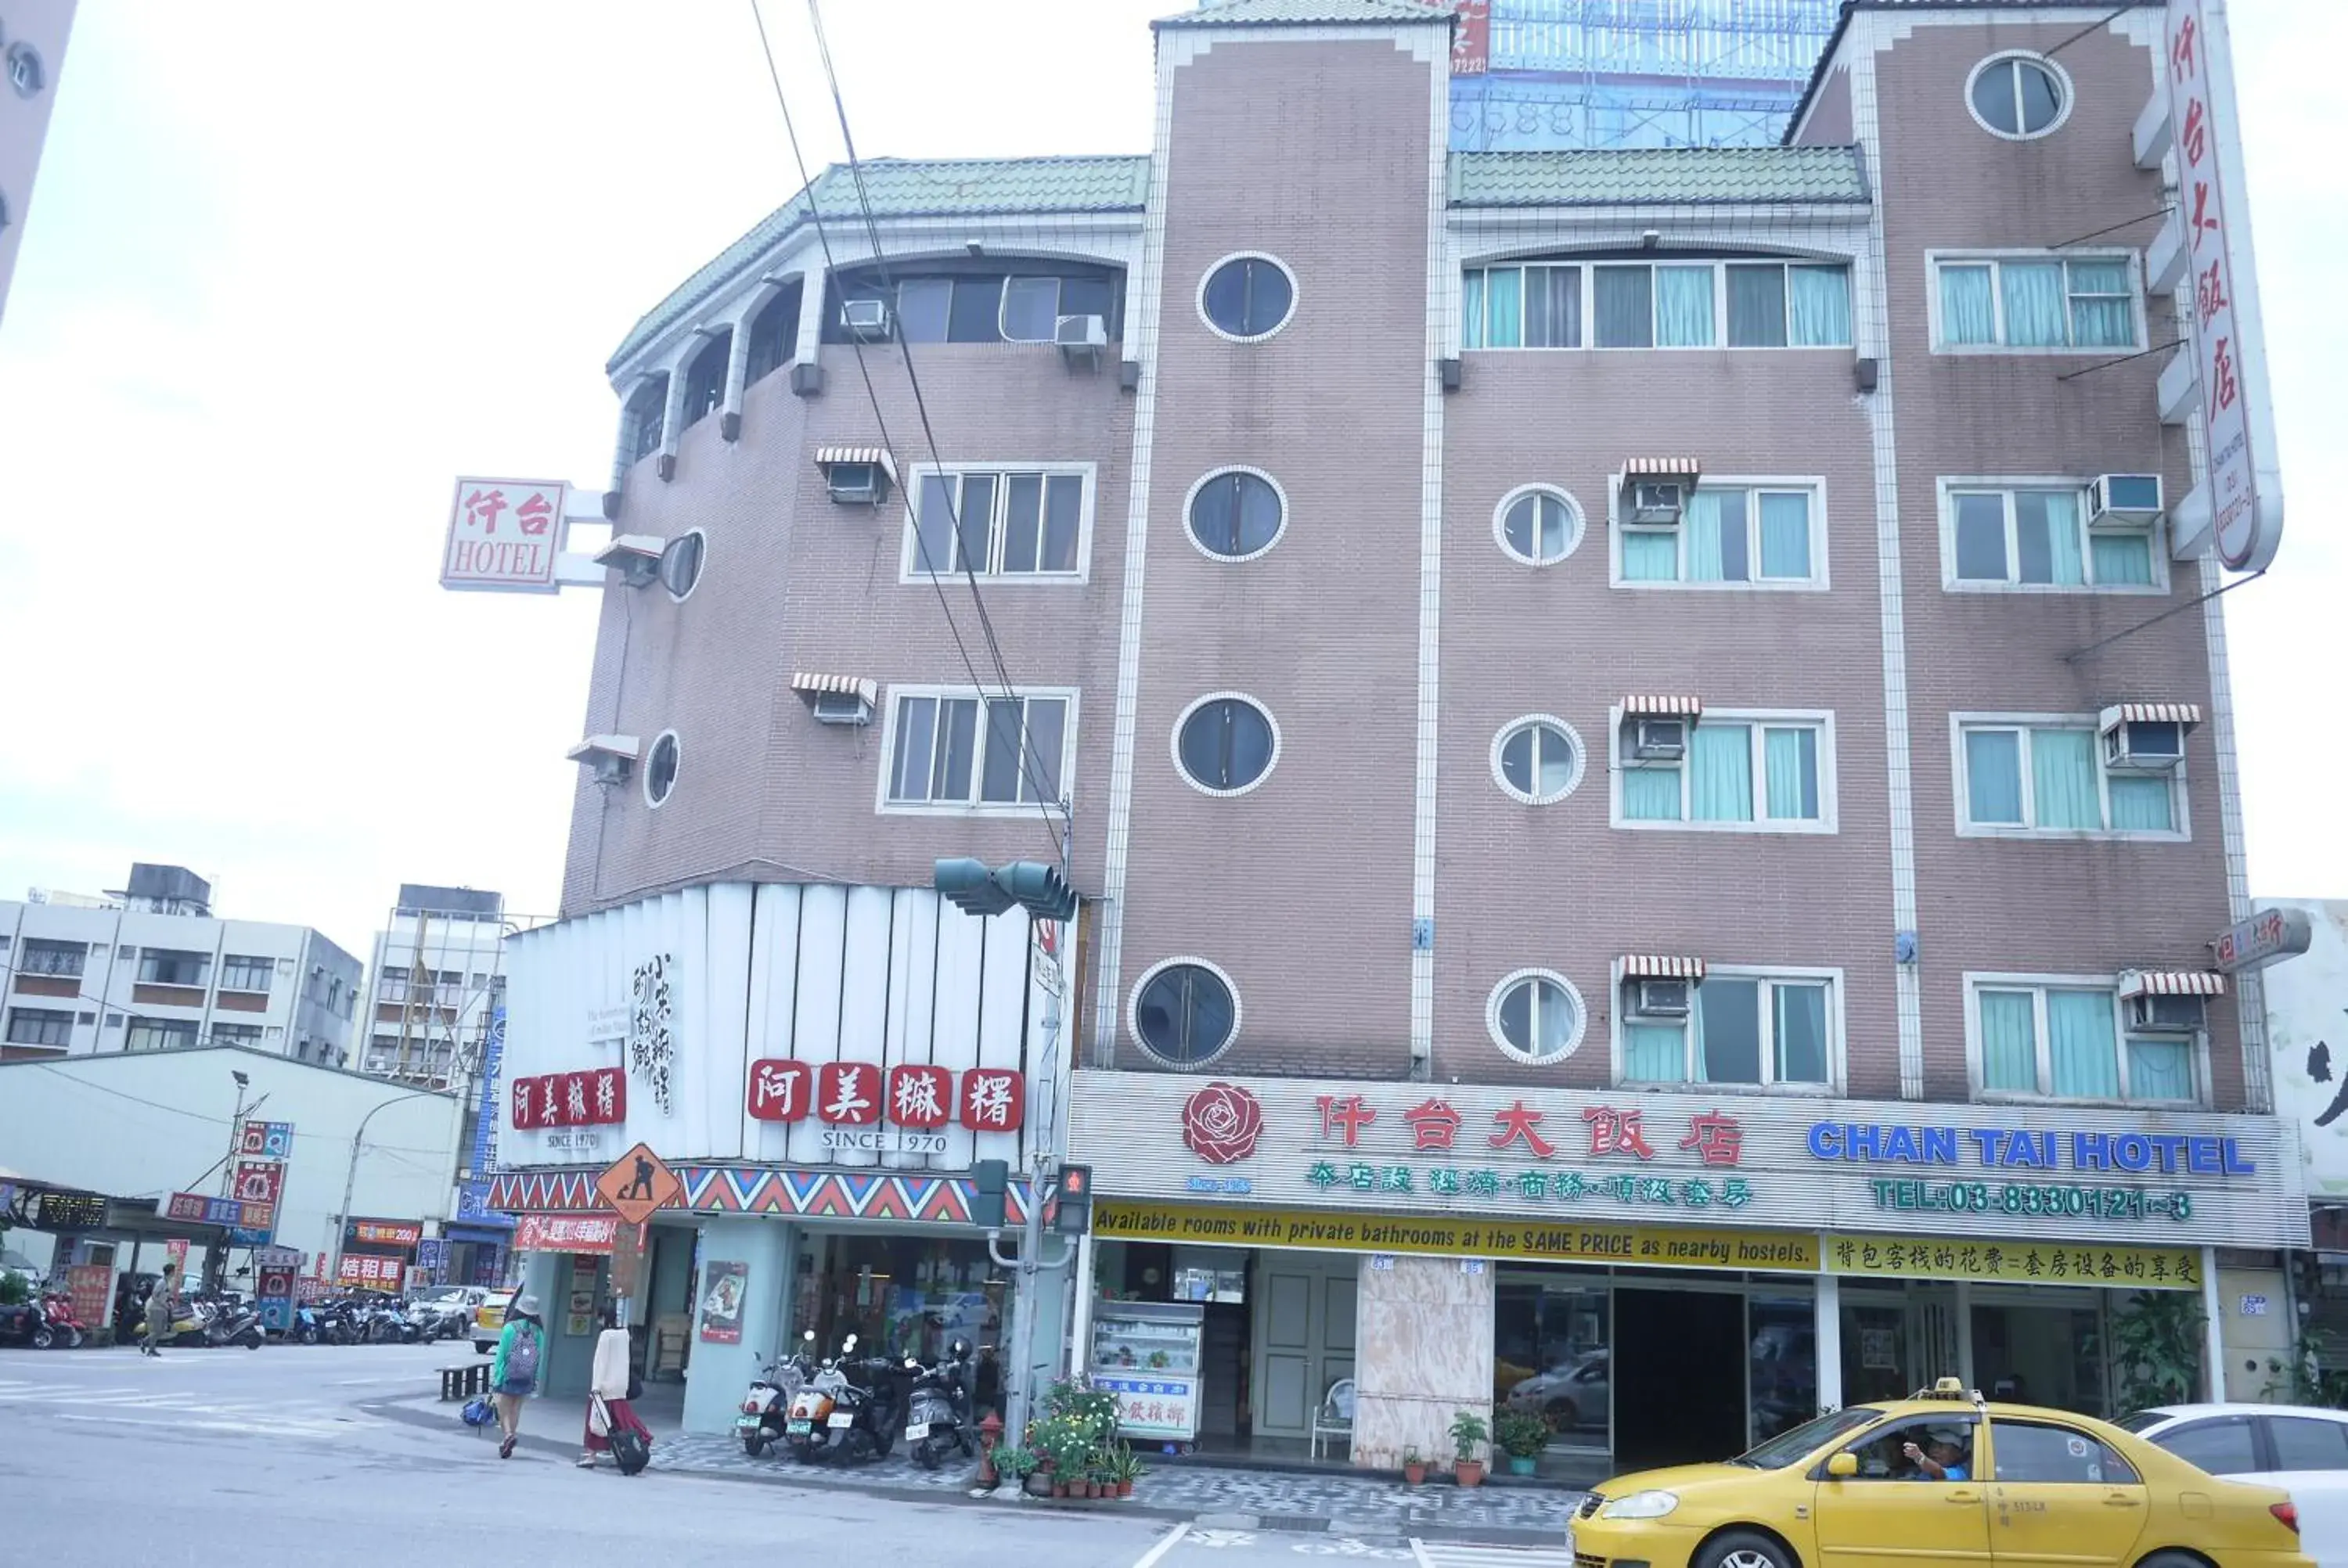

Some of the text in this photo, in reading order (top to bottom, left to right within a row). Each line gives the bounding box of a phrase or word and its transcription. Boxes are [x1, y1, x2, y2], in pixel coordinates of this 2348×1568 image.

[465, 489, 552, 535] 仟台
[453, 540, 546, 576] HOTEL
[547, 1133, 597, 1148] SINCE 1970
[823, 1131, 947, 1153] SINCE 1970
[1316, 1095, 1746, 1166] 仟台大飯店
[1808, 1120, 2256, 1174] CHAN TAI HOTEL
[1096, 1210, 1810, 1264] Available rooms with private bathrooms at the SAME PRICE as nearby hostels.
